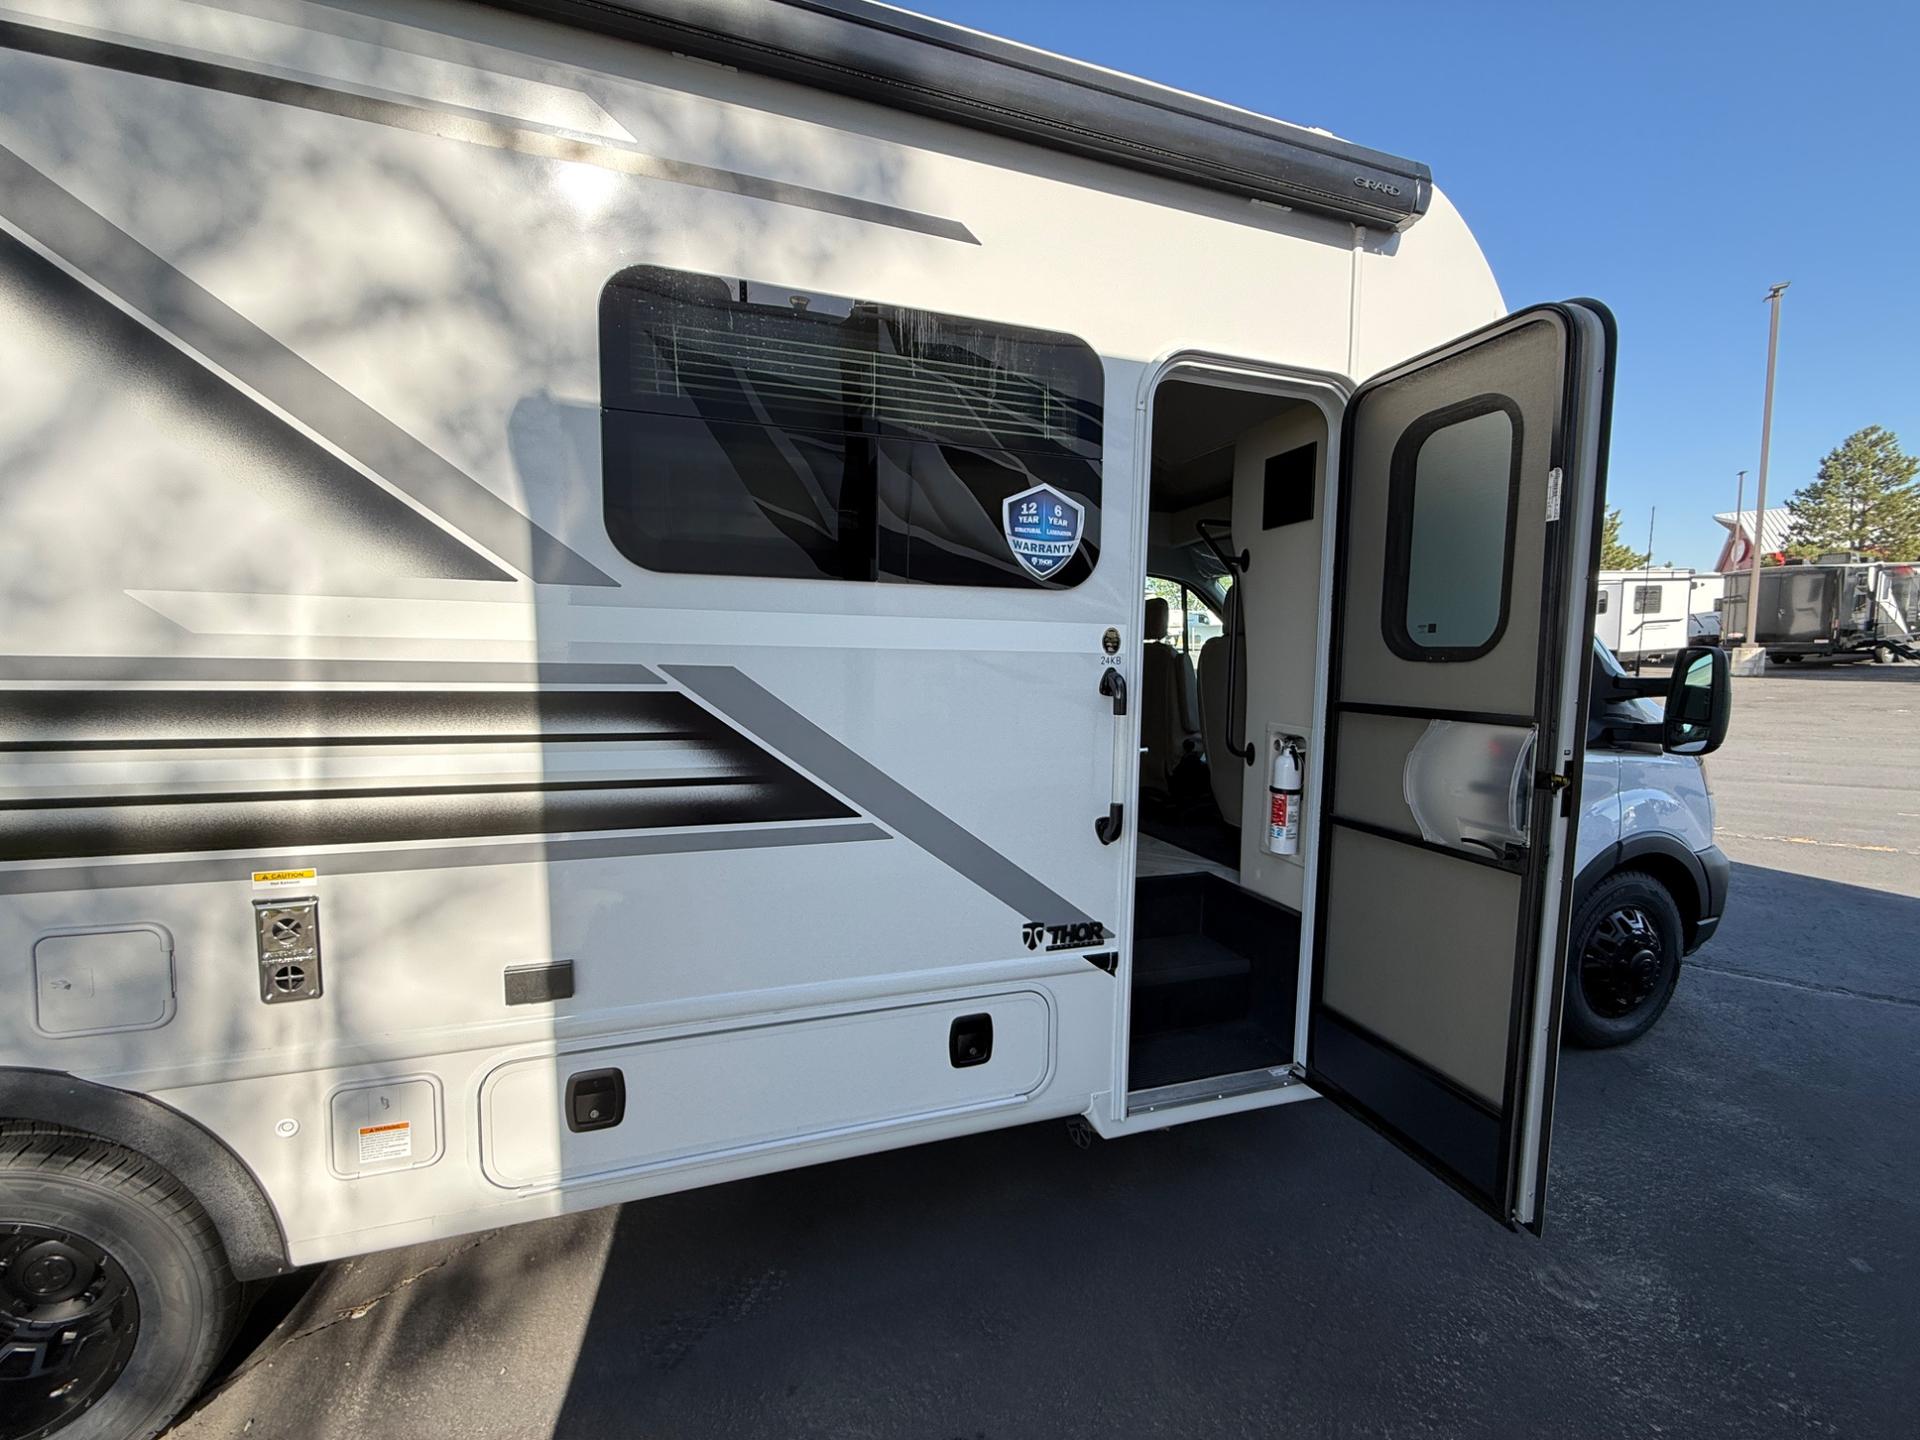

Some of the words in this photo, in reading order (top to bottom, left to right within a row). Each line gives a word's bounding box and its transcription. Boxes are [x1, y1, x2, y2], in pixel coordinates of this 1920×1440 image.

[1021, 502, 1037, 515] 12
[1054, 505, 1063, 517] 6
[1018, 515, 1040, 524] YEAR
[1048, 516, 1068, 528] YEAR
[1012, 539, 1075, 554] WARRANTY
[1100, 655, 1122, 666] 24KB
[271, 871, 305, 880] CAUTION
[1046, 921, 1104, 945] THOR
